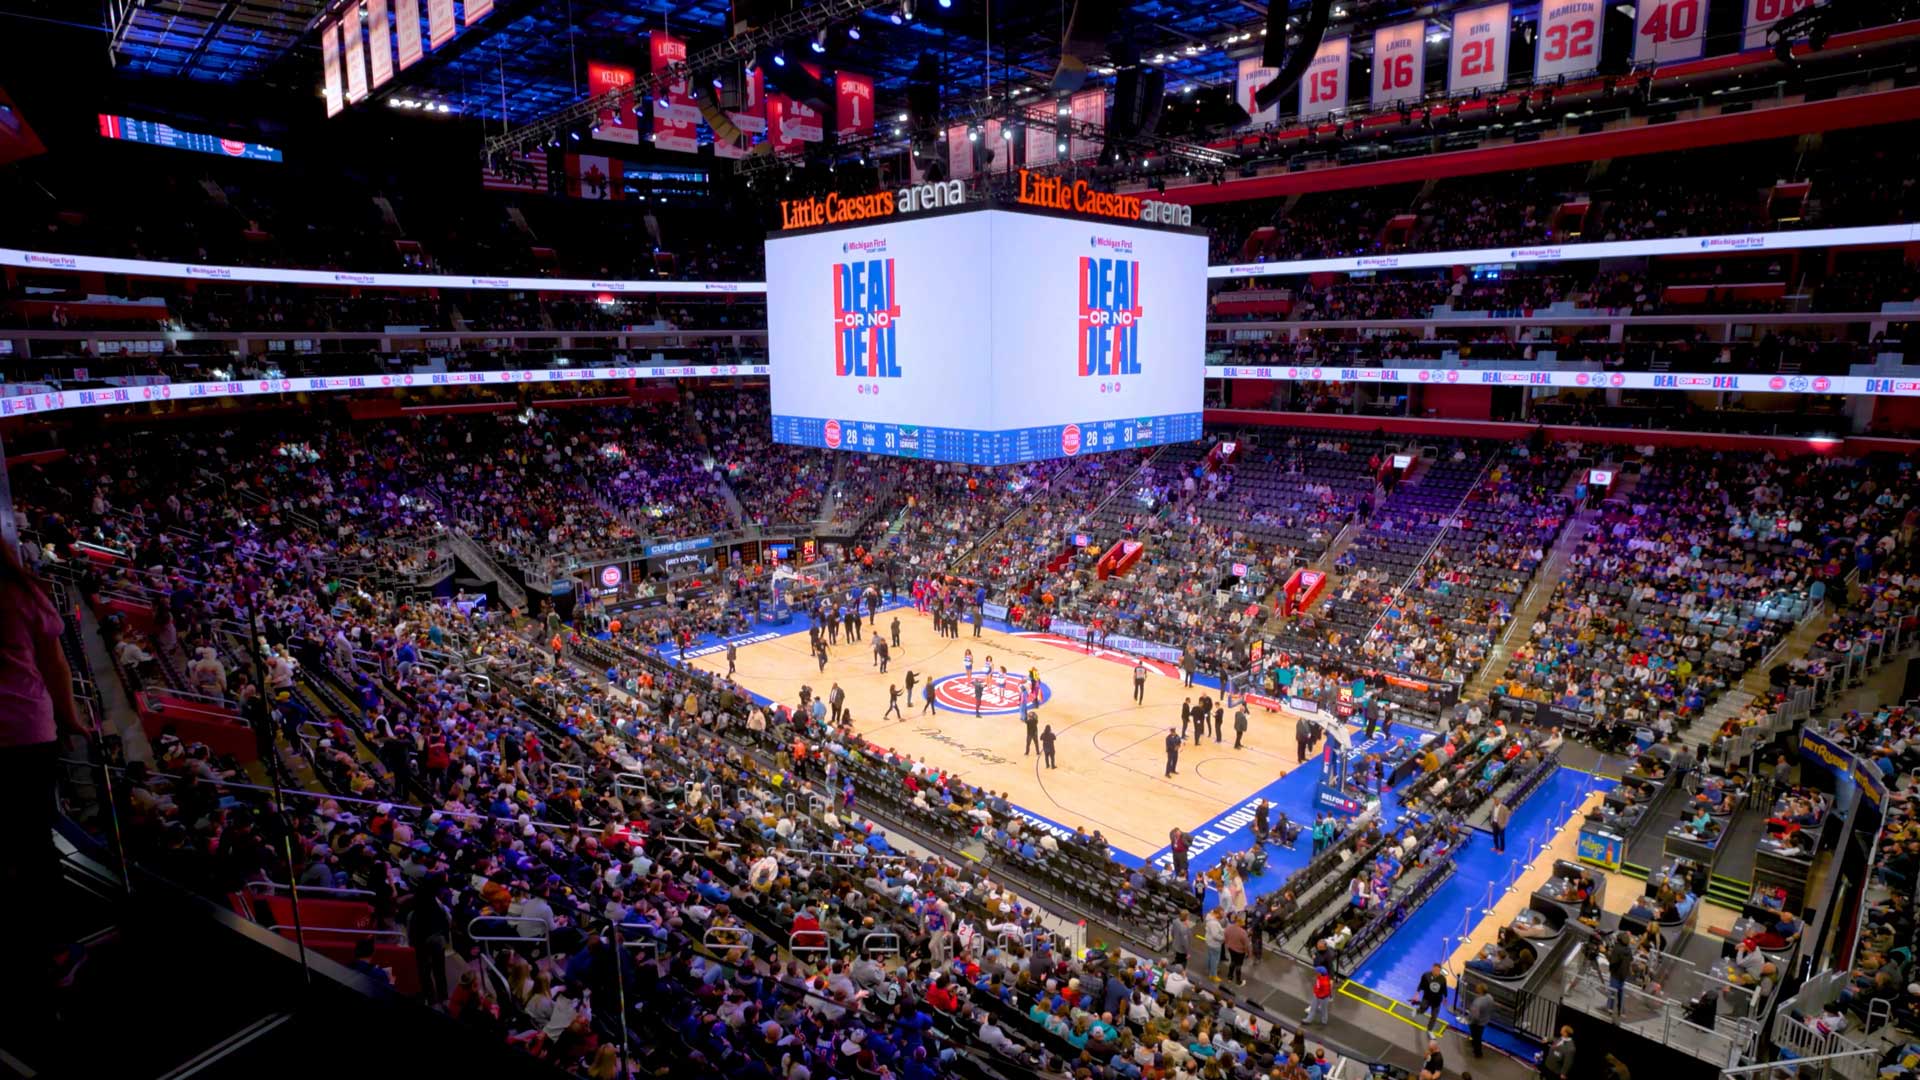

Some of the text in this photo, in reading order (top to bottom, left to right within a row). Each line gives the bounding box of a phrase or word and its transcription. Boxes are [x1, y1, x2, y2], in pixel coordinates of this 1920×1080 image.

[1550, 4, 1594, 18] HAMILTON
[1641, 0, 1698, 43] 40
[1470, 24, 1490, 36] BING
[1544, 19, 1595, 61] 32
[1311, 55, 1340, 67] OHNSON
[1461, 37, 1495, 77] 21
[601, 70, 624, 86] KELLY
[1382, 54, 1414, 91] 16
[1309, 69, 1338, 104] 15
[852, 96, 861, 126] 1
[781, 179, 966, 230] Little Caesars arena
[1018, 168, 1192, 227] Little Caesars arena
[833, 258, 901, 318] DEAL
[1079, 256, 1143, 318] DEAL
[845, 313, 888, 326] OR NO
[1090, 311, 1132, 324] OR NO
[834, 319, 902, 378] DEAL
[1078, 318, 1142, 376] DEAL
[1341, 369, 1358, 380] DEAL
[1482, 372, 1502, 383] DEAL
[1530, 372, 1552, 384] DEAL
[1653, 375, 1679, 387] DEAL
[1712, 376, 1740, 389] DEAL
[1865, 379, 1896, 393] DEAL
[885, 433, 895, 449] 31
[1124, 427, 1133, 443] 31
